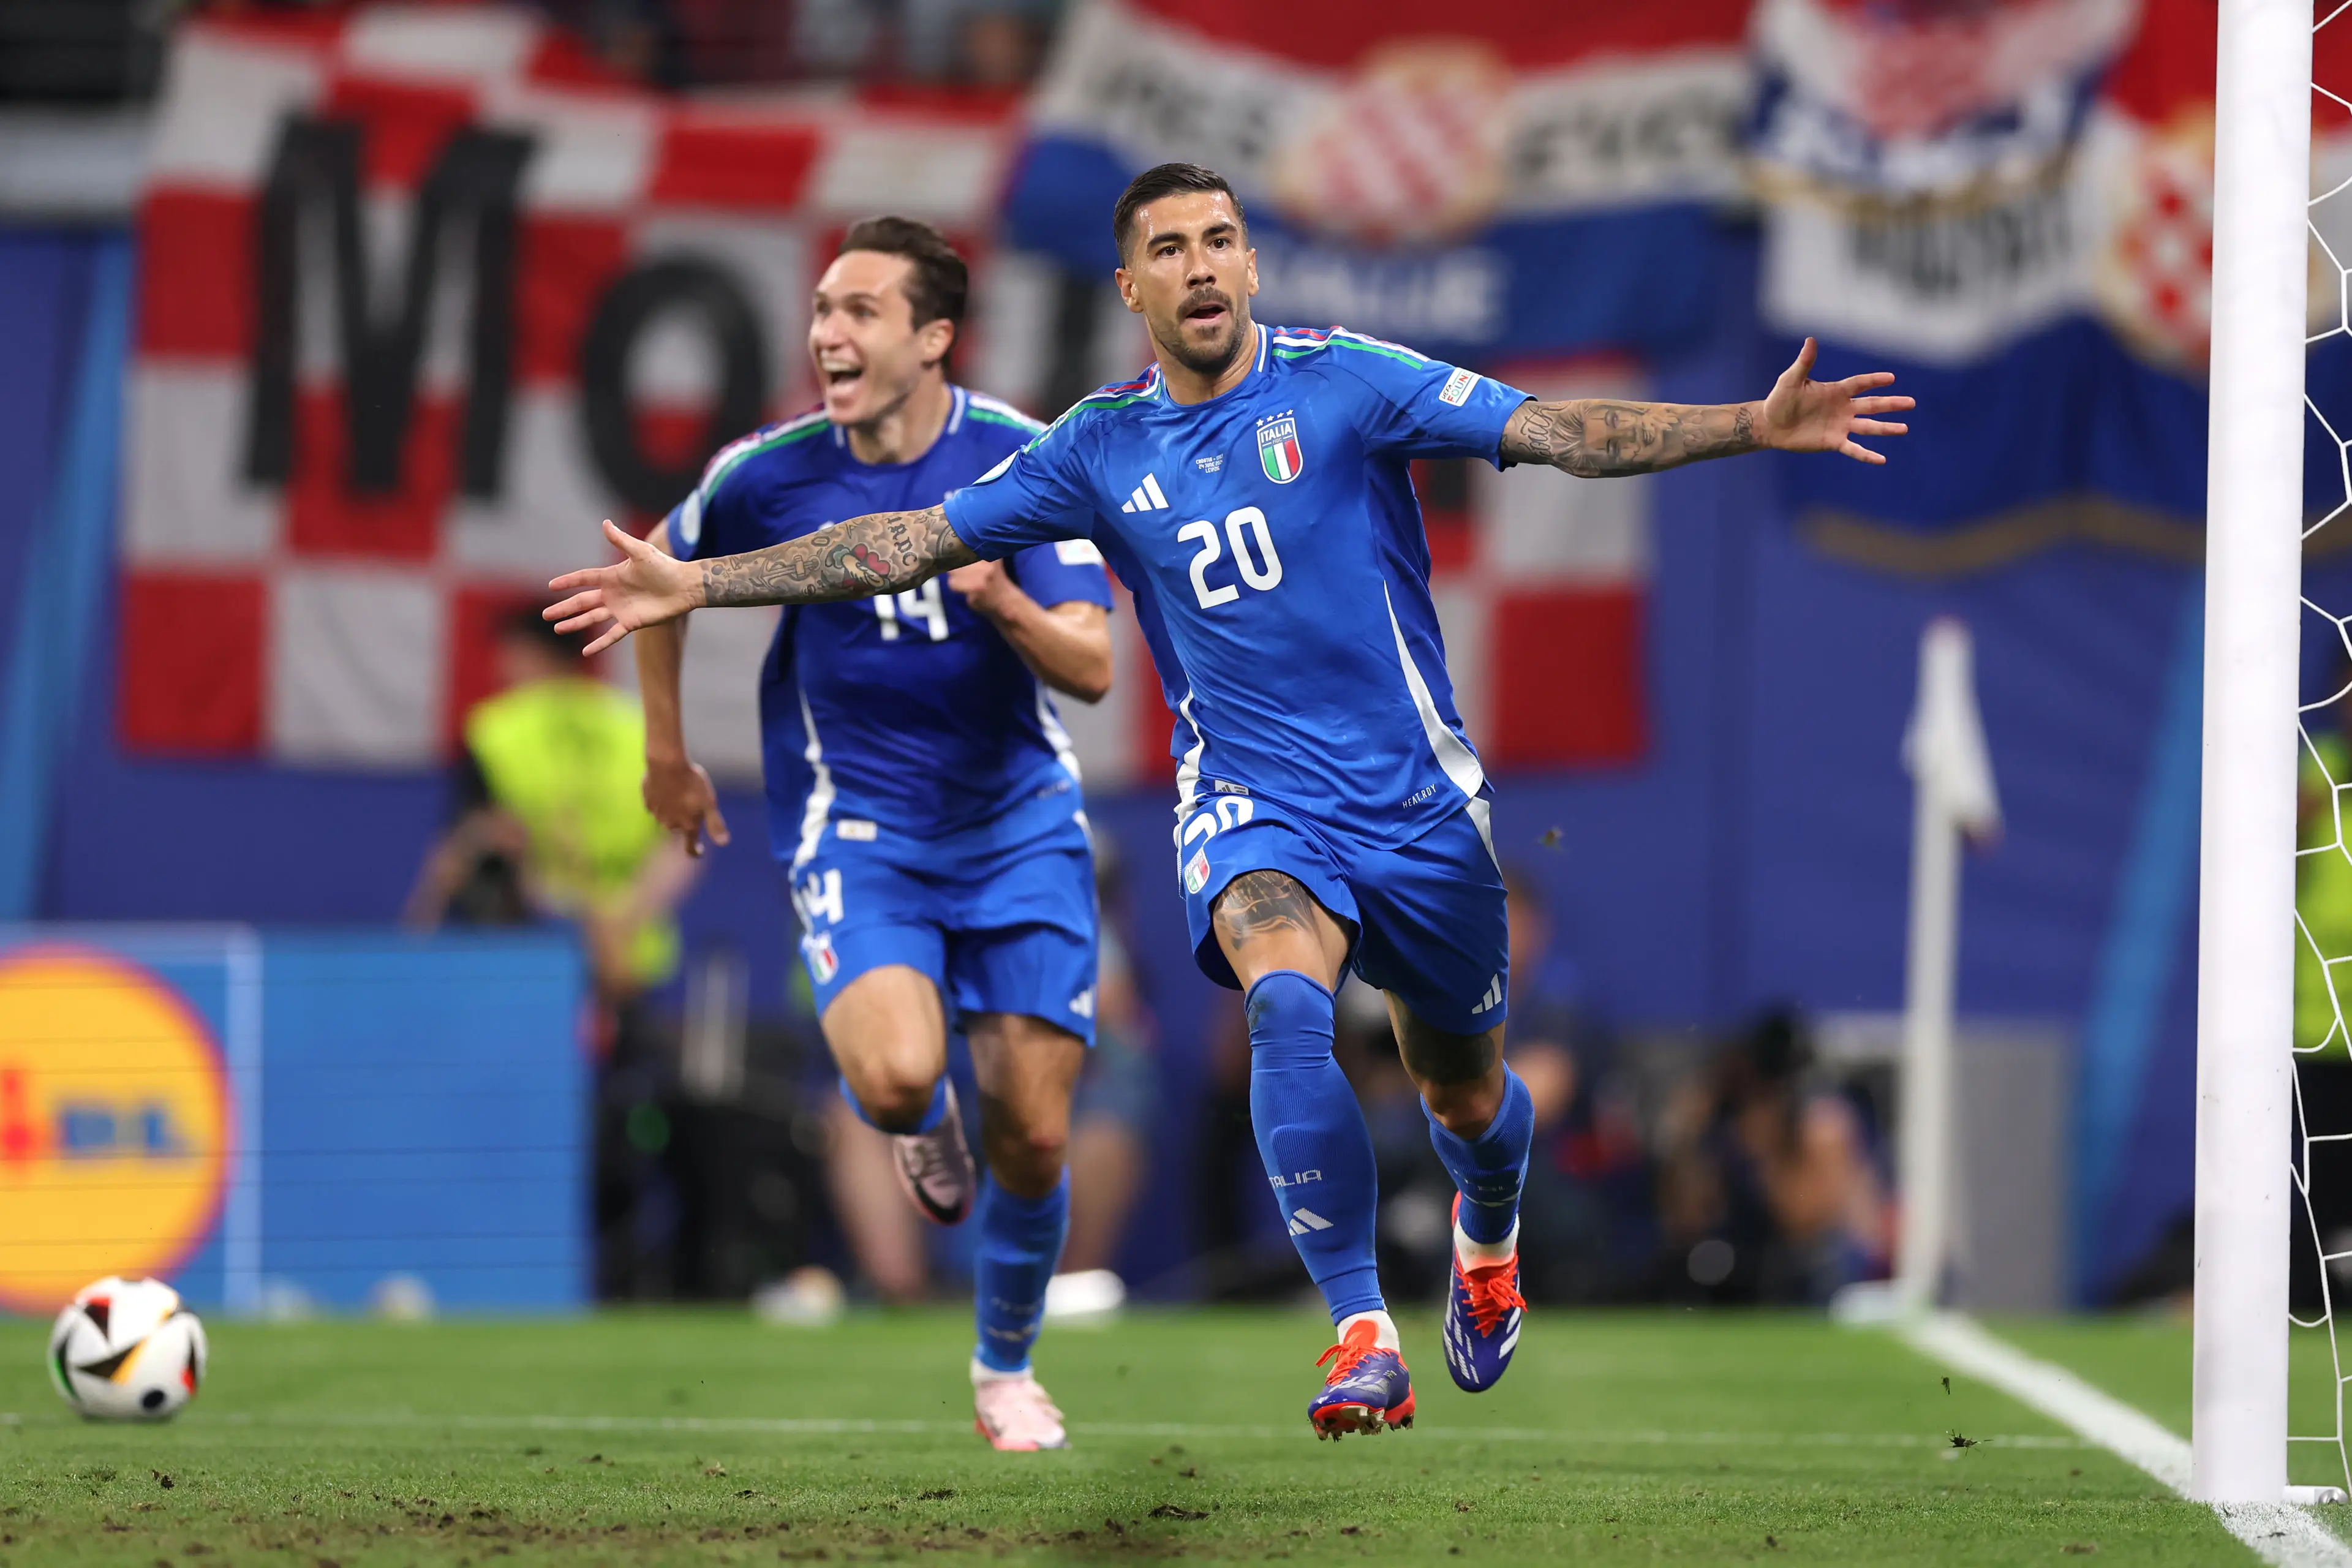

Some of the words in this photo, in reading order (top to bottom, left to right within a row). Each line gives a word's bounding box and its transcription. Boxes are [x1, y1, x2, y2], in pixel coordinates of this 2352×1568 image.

[1260, 423, 1292, 443] ITALIA
[1177, 506, 1283, 609] 20
[1402, 783, 1436, 809] HEAT.RDY
